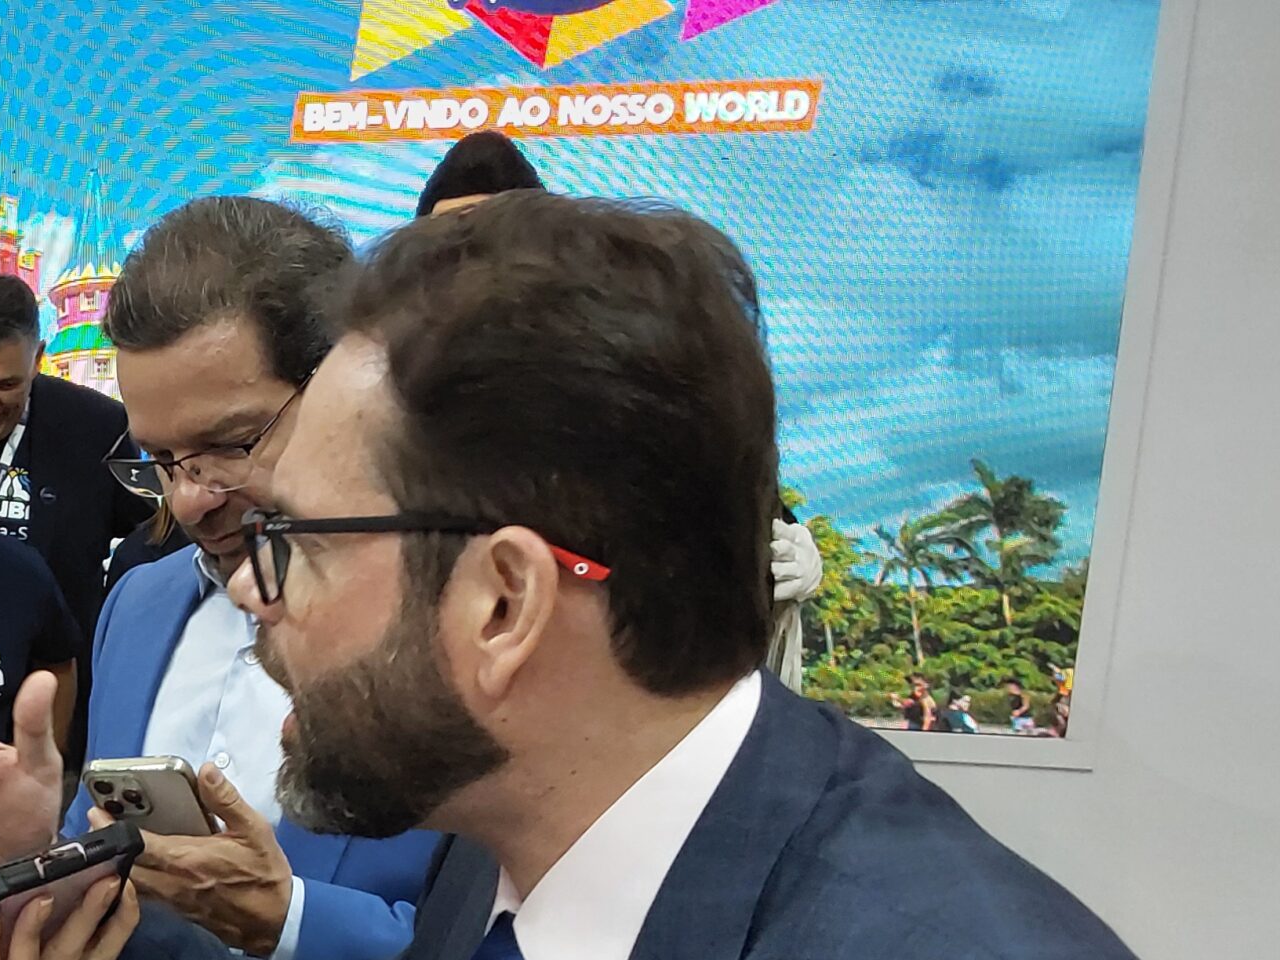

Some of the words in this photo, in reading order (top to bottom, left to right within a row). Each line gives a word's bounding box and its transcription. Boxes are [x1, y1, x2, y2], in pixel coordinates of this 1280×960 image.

[303, 98, 489, 132] BEM-VINDO
[497, 95, 551, 128] AO
[557, 93, 675, 127] NOSSO
[683, 89, 810, 123] WORLD
